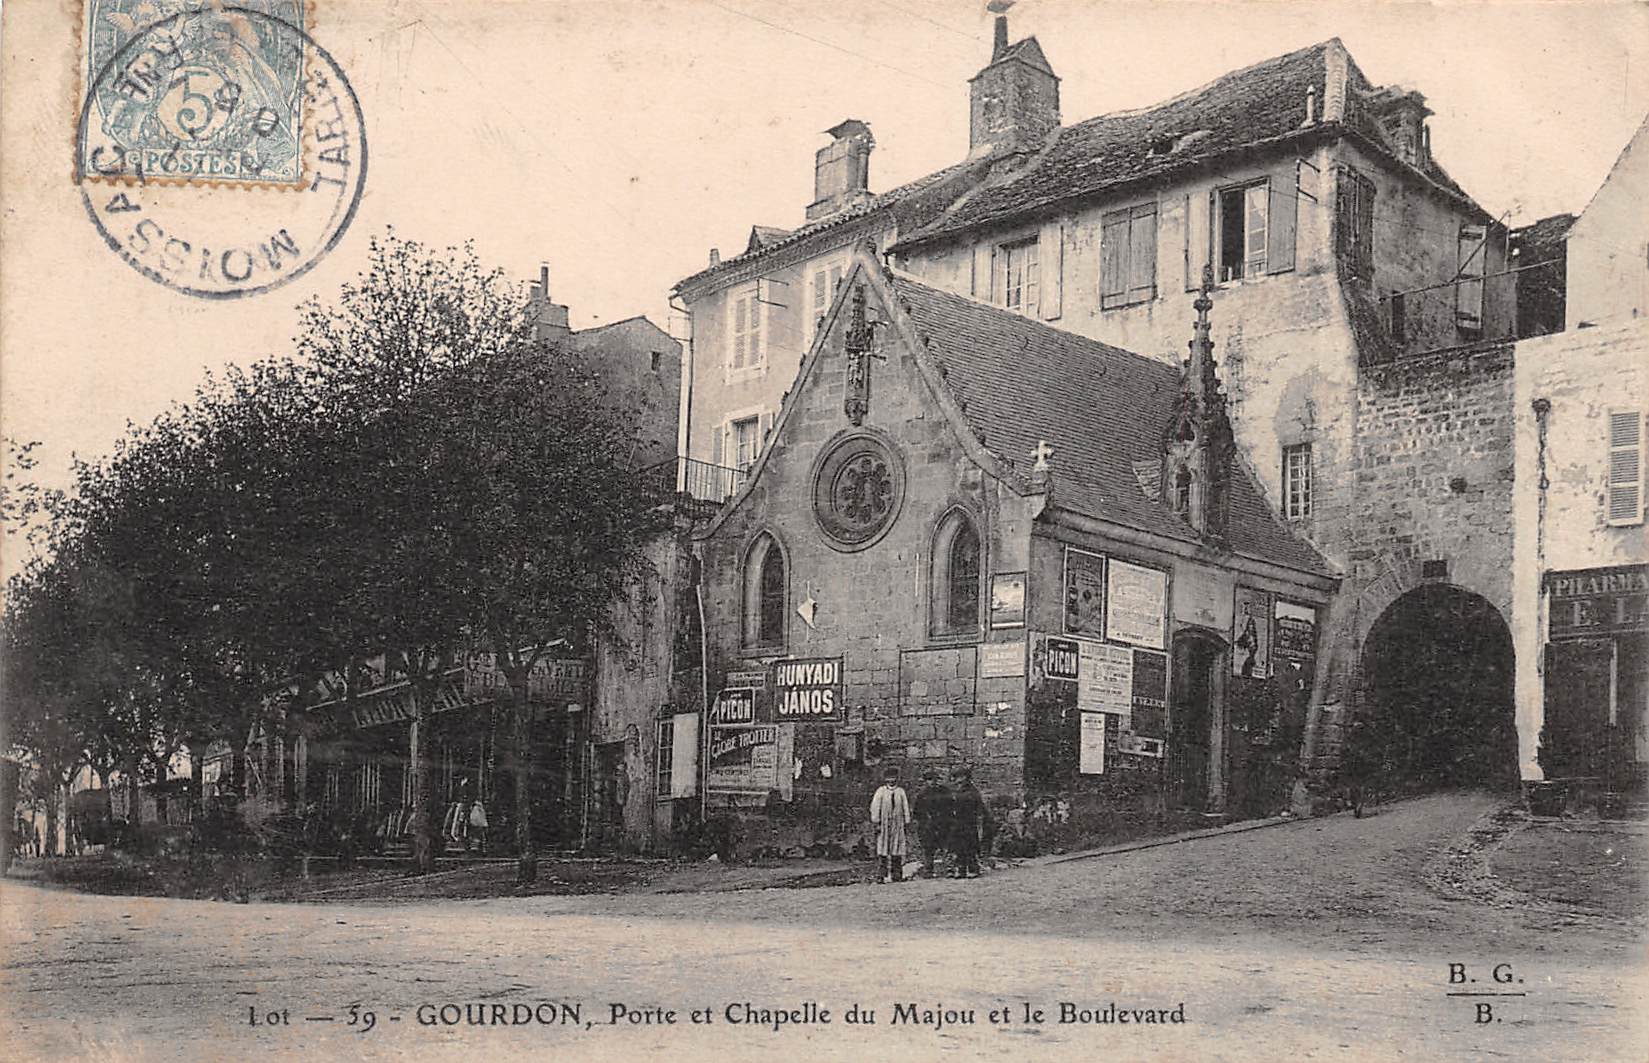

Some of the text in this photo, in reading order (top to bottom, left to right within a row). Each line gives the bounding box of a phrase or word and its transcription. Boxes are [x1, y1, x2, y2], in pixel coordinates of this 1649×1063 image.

[176, 70, 214, 133] 5
[145, 151, 242, 177] POSTES
[91, 145, 301, 283] MOISSAC
[777, 662, 839, 687] HUNYADI
[1048, 649, 1079, 675] PICON
[720, 699, 751, 720] PICON
[778, 686, 834, 715] JÁNOS
